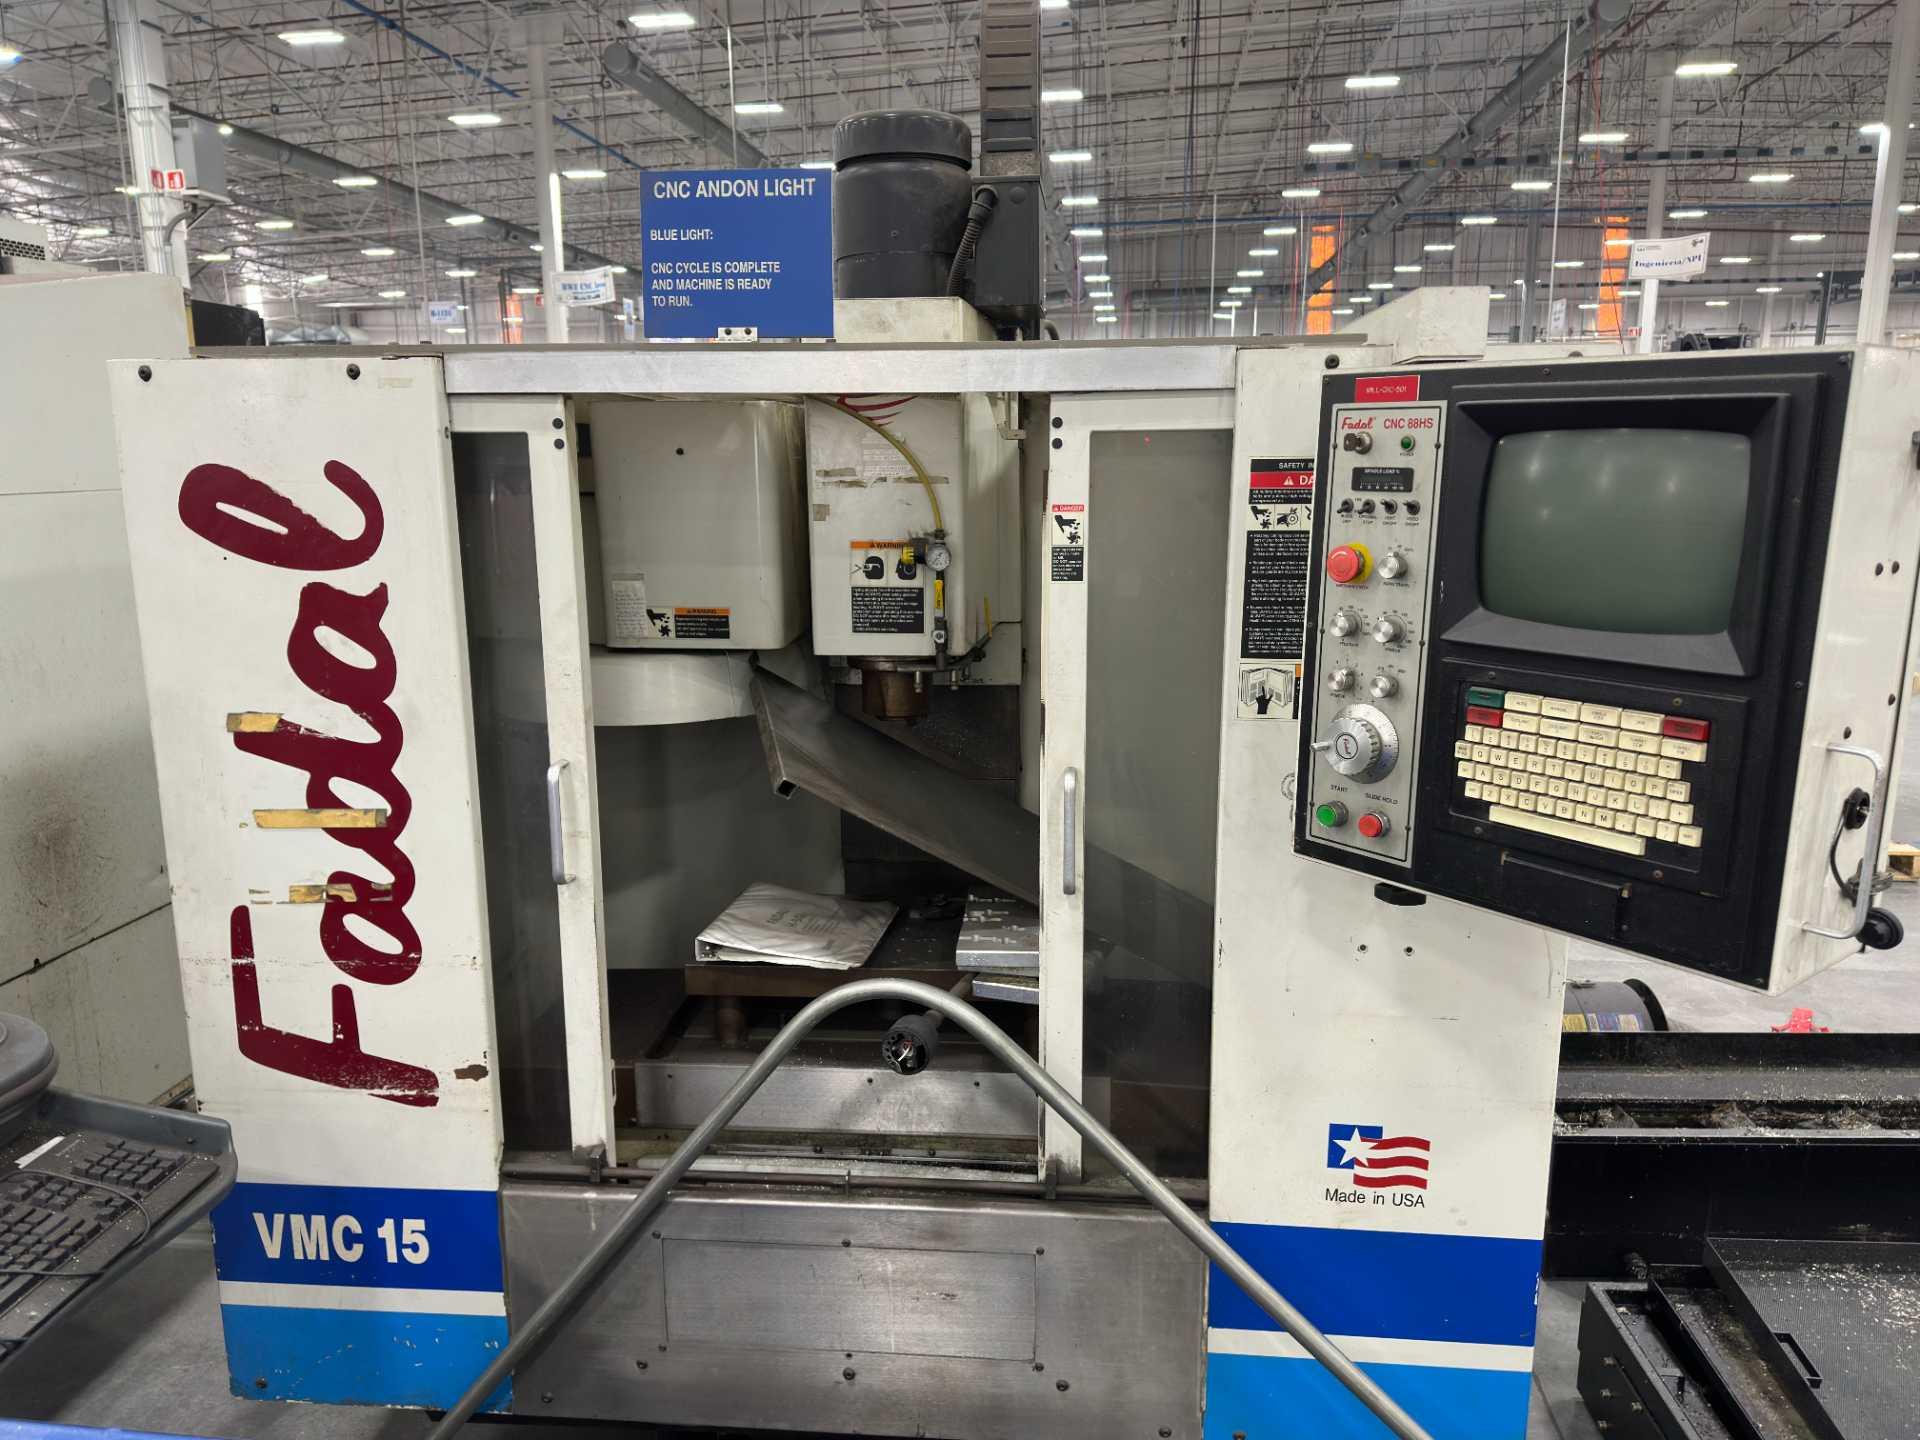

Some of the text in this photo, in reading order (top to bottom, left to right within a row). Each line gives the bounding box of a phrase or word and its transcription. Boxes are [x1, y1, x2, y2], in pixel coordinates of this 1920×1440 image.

[653, 178, 816, 199] CNC ANDON LIGHT
[650, 229, 714, 241] BLUE LIGHT:
[651, 261, 781, 274] CNC CYCLE IS COMPLETE
[651, 278, 772, 290] AND MACHINE IS READY
[652, 295, 693, 307] TO RUN.
[1383, 418, 1405, 430] CNC
[1408, 417, 1434, 430] 88HS
[178, 459, 440, 1107] Fadal
[1325, 1188, 1425, 1208] Made in USA
[252, 1212, 430, 1265] VMC 15
